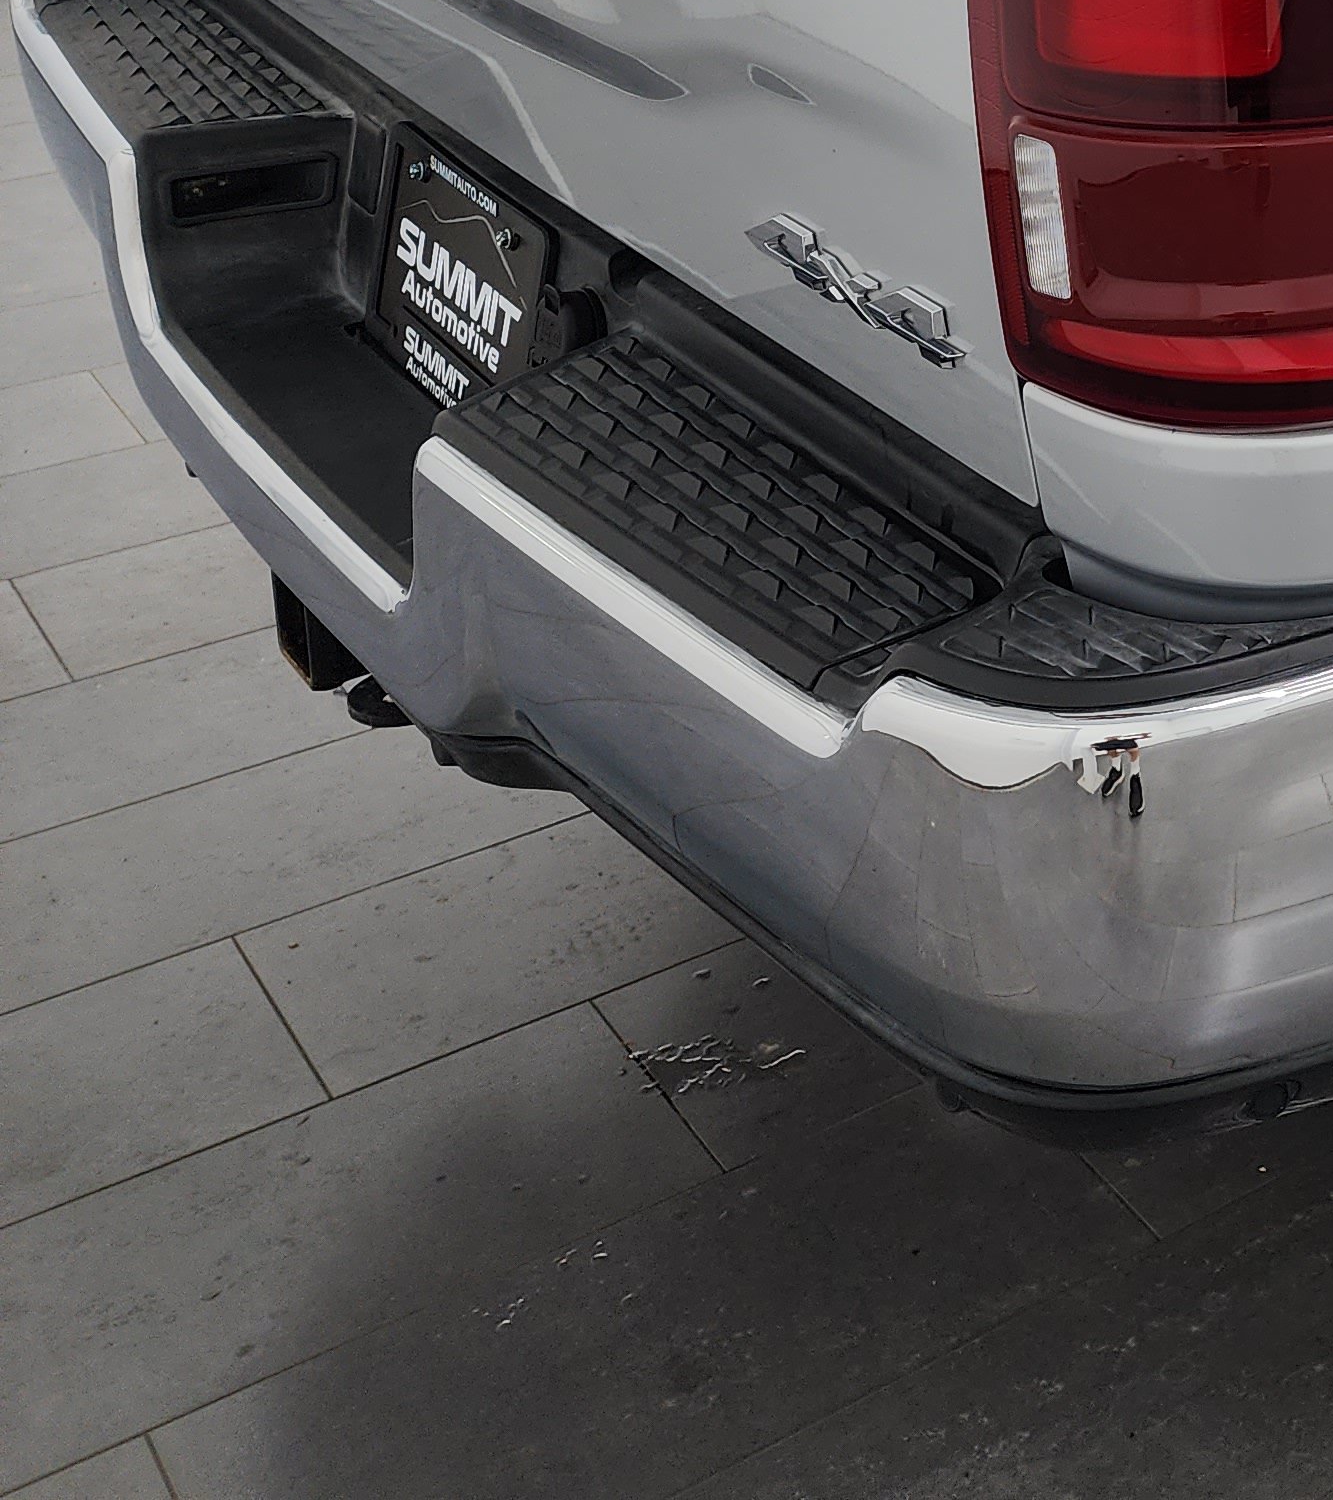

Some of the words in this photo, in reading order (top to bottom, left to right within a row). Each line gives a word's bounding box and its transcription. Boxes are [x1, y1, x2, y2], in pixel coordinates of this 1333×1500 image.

[429, 154, 498, 218] SUMMITAUTO.COM
[396, 216, 523, 348] SUMMIT
[401, 269, 499, 374] Automotive
[403, 326, 470, 399] SUMMIT
